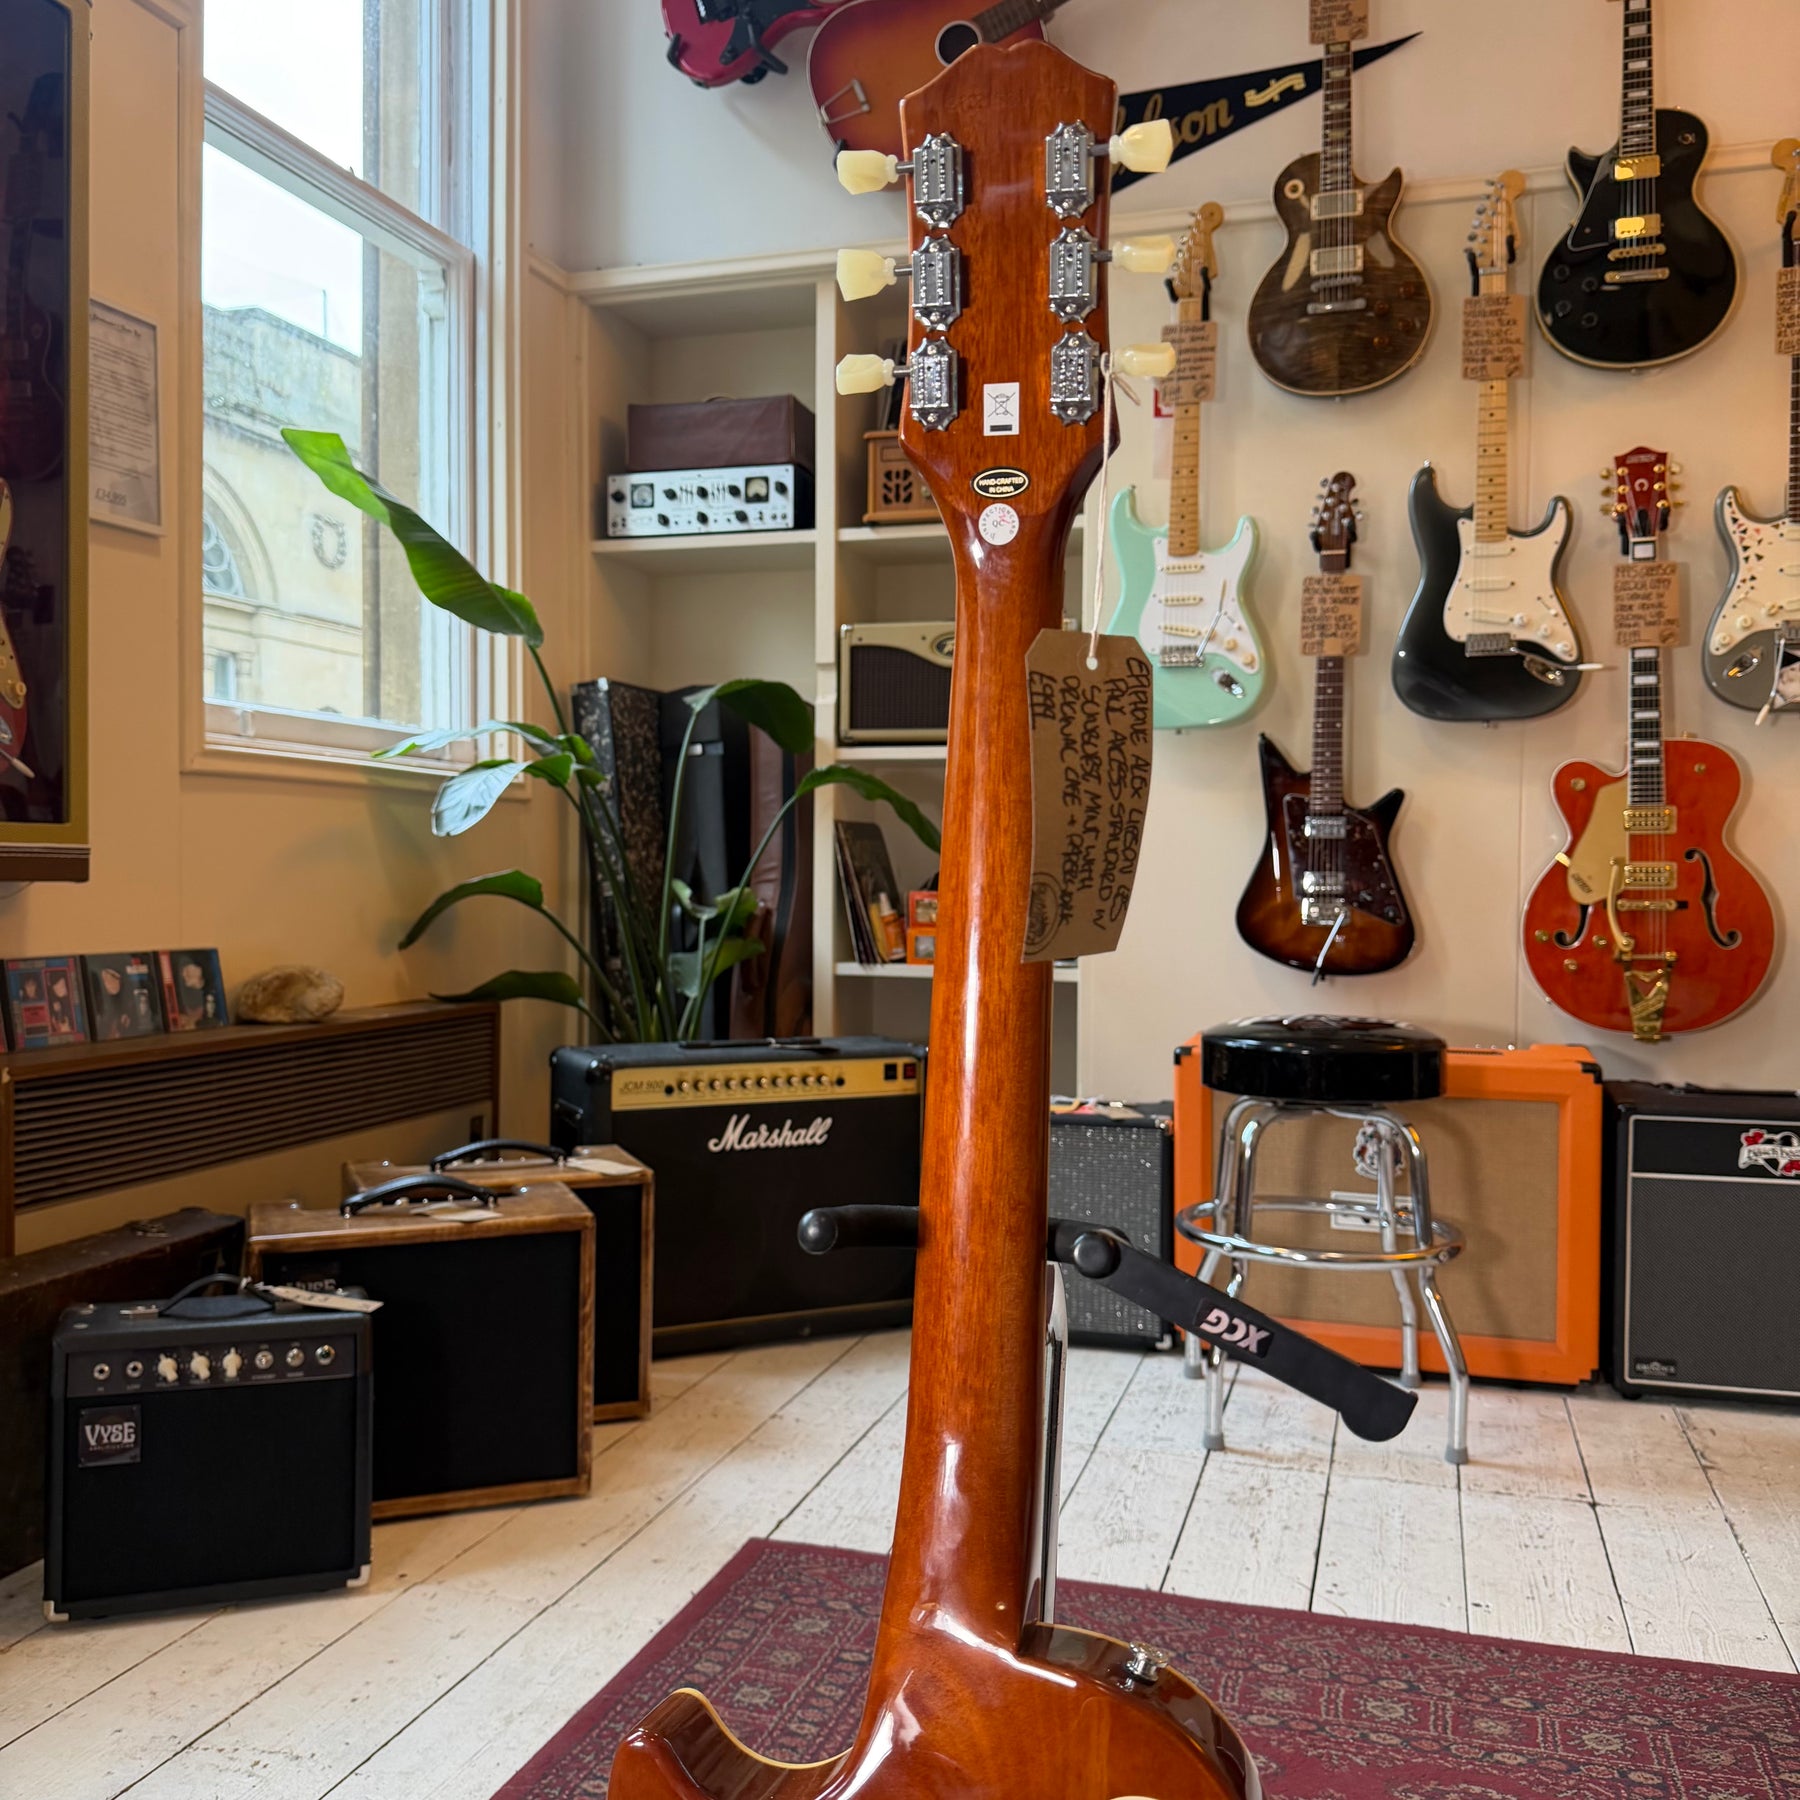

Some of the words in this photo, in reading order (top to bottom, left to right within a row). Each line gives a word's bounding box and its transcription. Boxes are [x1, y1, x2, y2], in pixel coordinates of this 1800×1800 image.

[979, 477, 1024, 486] HAND-CRAFTED
[1059, 675, 1081, 763] ORIGINAL
[1103, 677, 1129, 726] PAUL
[1126, 657, 1150, 745] EPIPHONE
[1079, 685, 1103, 785] SUNBURST
[1062, 766, 1082, 807] CASE
[1130, 753, 1151, 799] ALEX
[1081, 789, 1103, 841] MINT
[1077, 845, 1097, 892] WITH
[1098, 802, 1126, 902] STANDARD
[1092, 908, 1107, 931] IN
[707, 1113, 833, 1153] Marshall
[1199, 1307, 1271, 1354] XCG
[84, 1421, 137, 1446] VYSE
